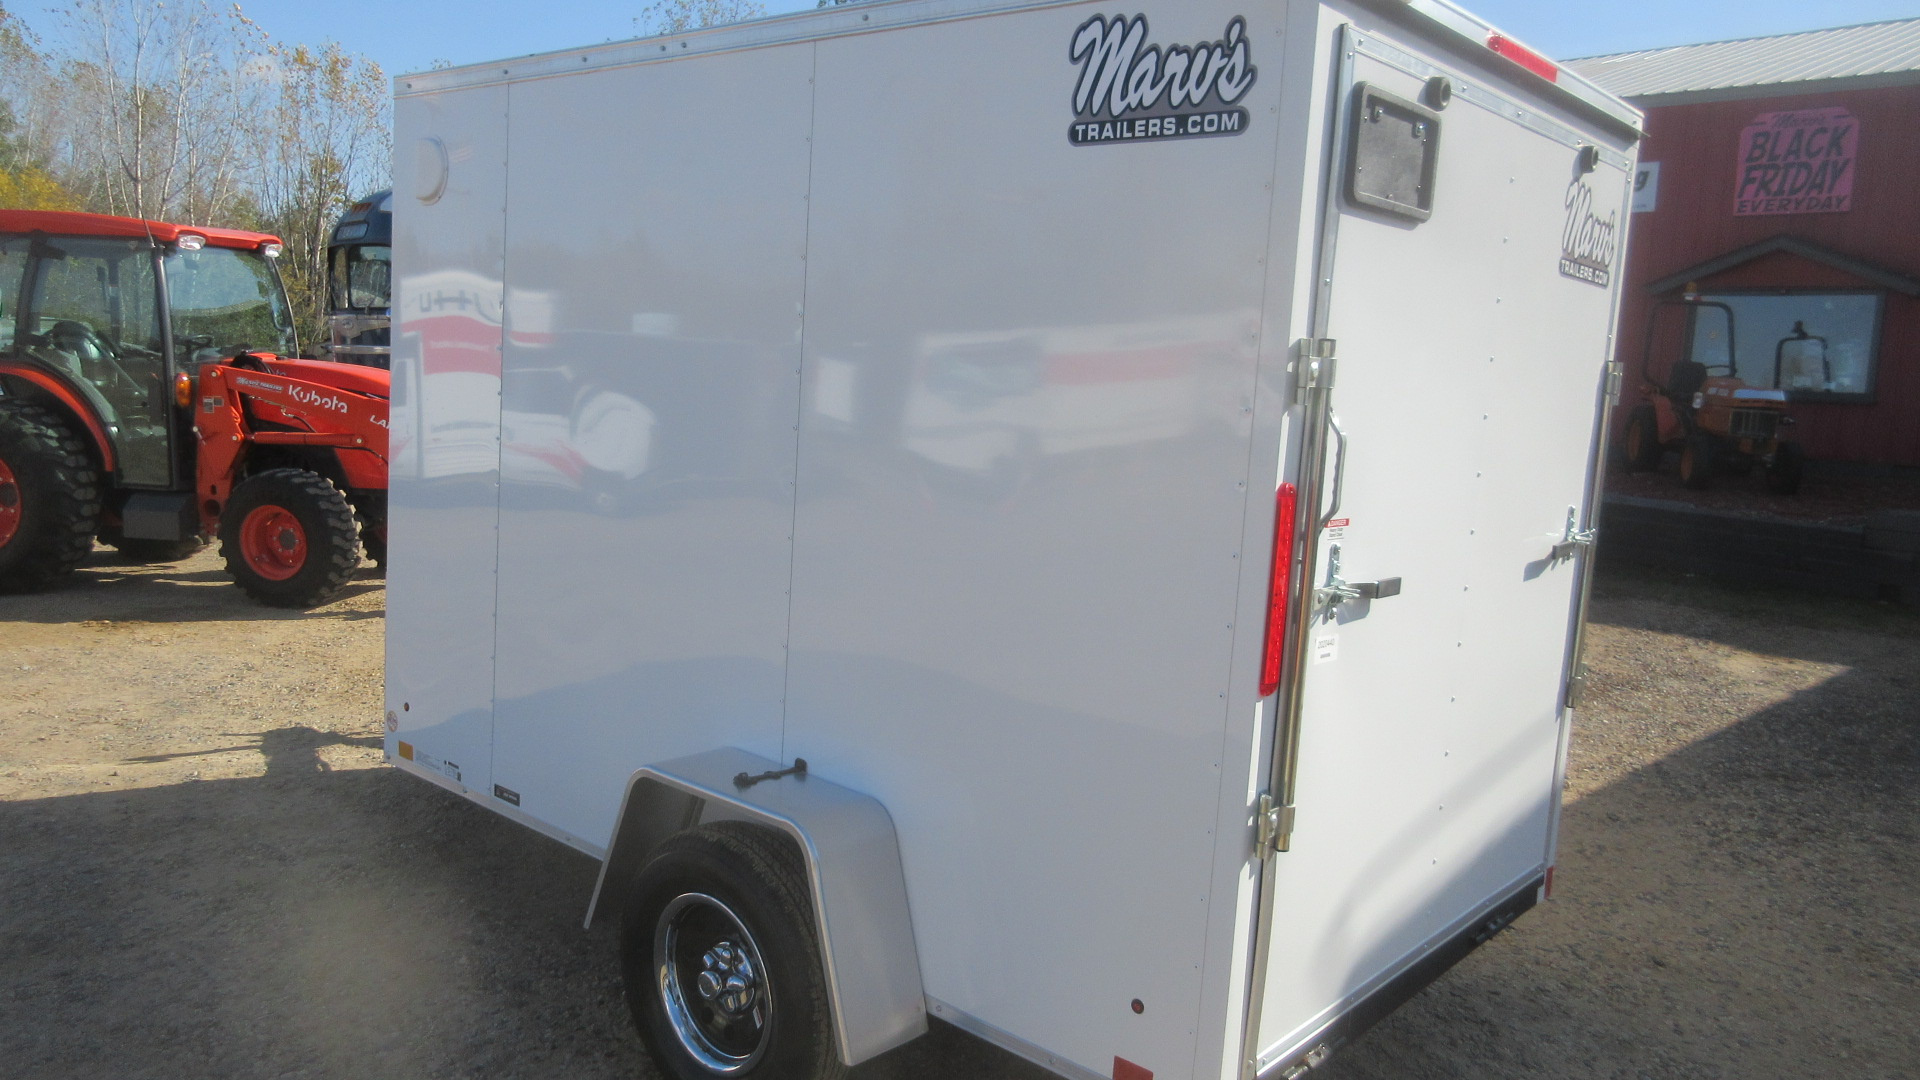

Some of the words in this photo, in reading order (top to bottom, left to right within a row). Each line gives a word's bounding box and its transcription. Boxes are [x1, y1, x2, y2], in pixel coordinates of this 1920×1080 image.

[1072, 15, 1255, 117] Marv's
[1075, 112, 1240, 141] TRAILERS.COM
[1745, 125, 1853, 163] BLACK
[1738, 158, 1851, 199] FRIDAY
[1736, 195, 1849, 213] EVERYDAY
[1563, 180, 1615, 268] Marv's
[1560, 258, 1609, 285] TRAILERS.COM
[288, 384, 348, 414] Kubota
